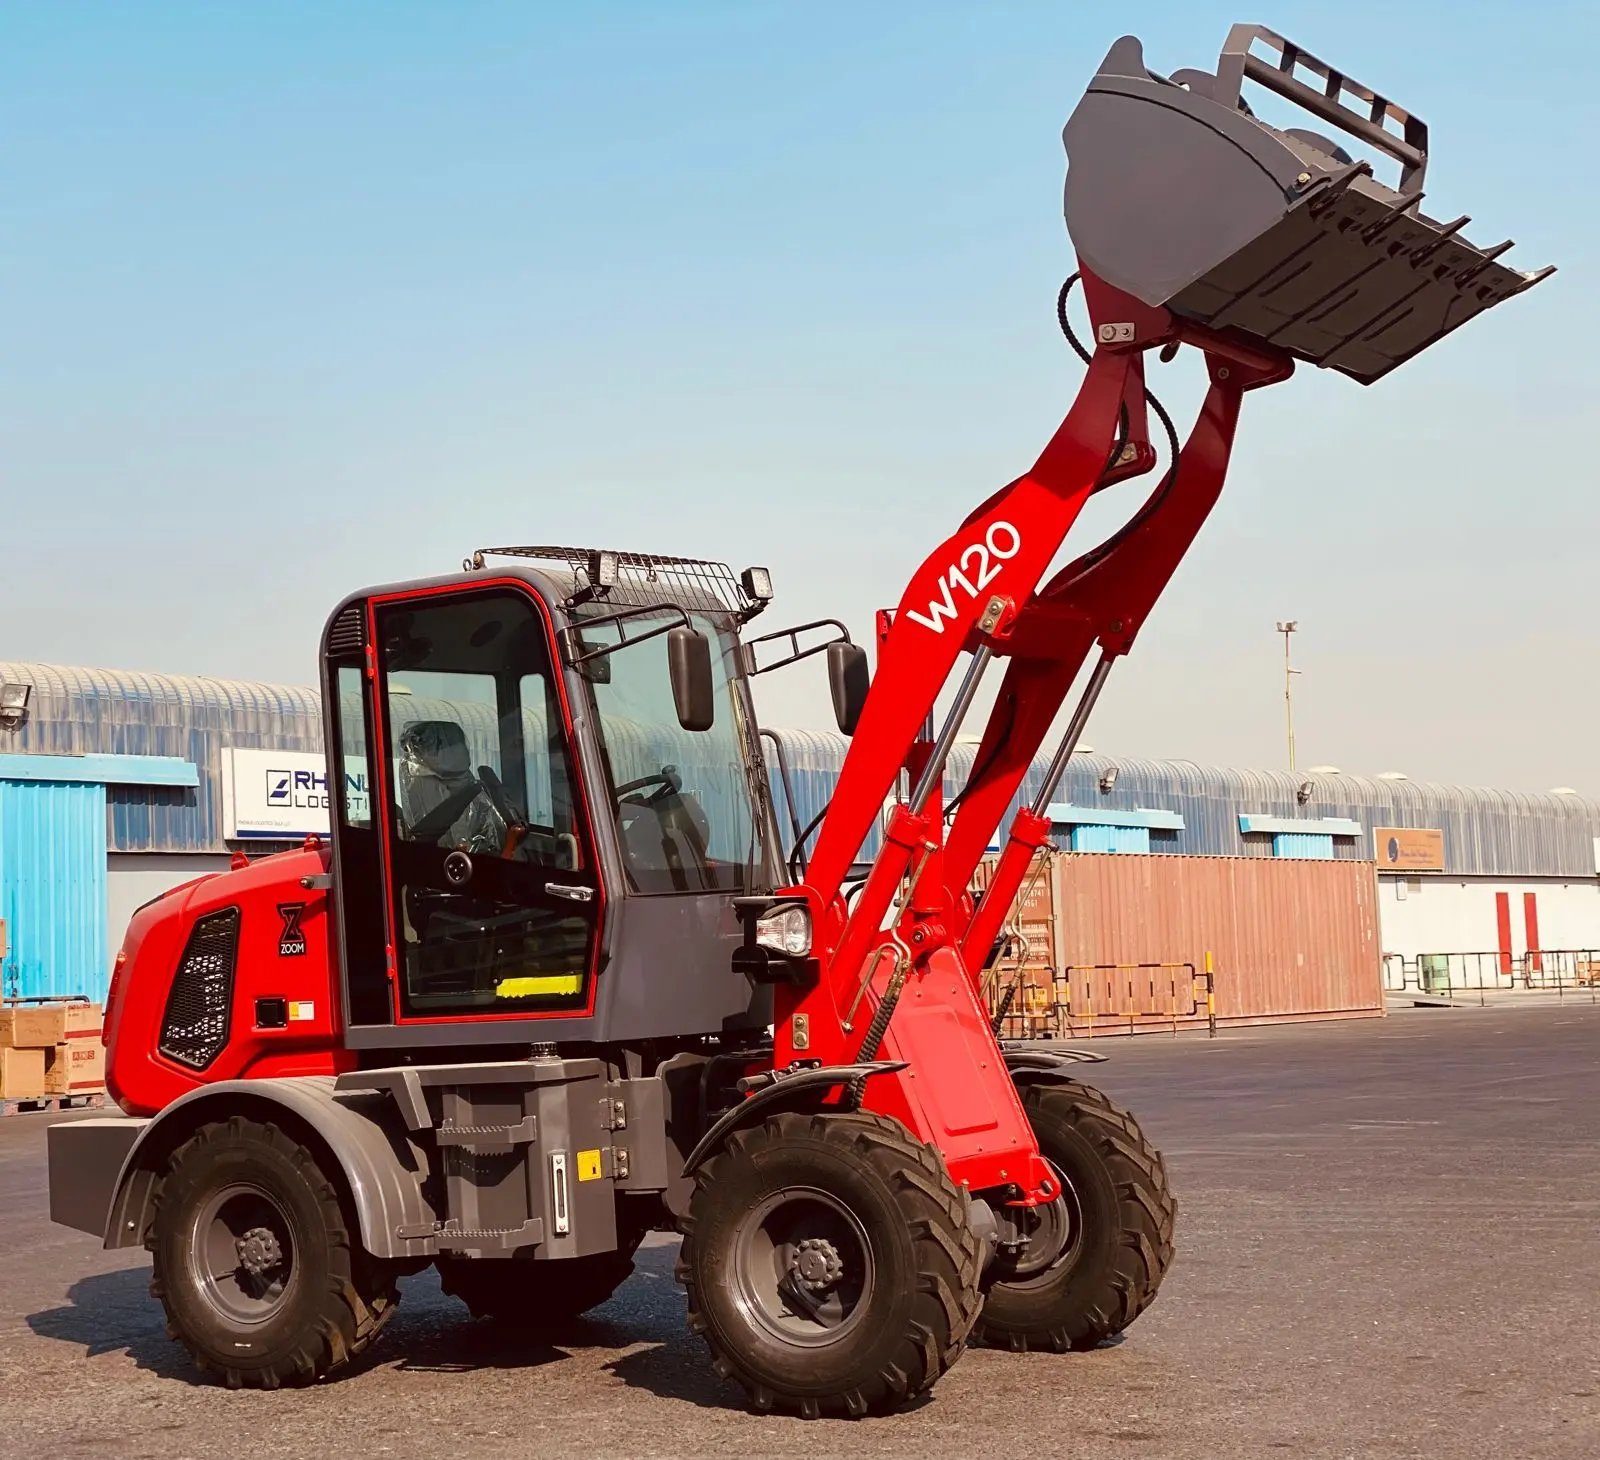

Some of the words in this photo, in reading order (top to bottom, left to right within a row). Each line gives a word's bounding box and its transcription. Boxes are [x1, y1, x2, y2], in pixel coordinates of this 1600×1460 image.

[905, 521, 1021, 634] W120
[294, 771, 369, 793] RHN
[281, 943, 304, 954] ZOOM
